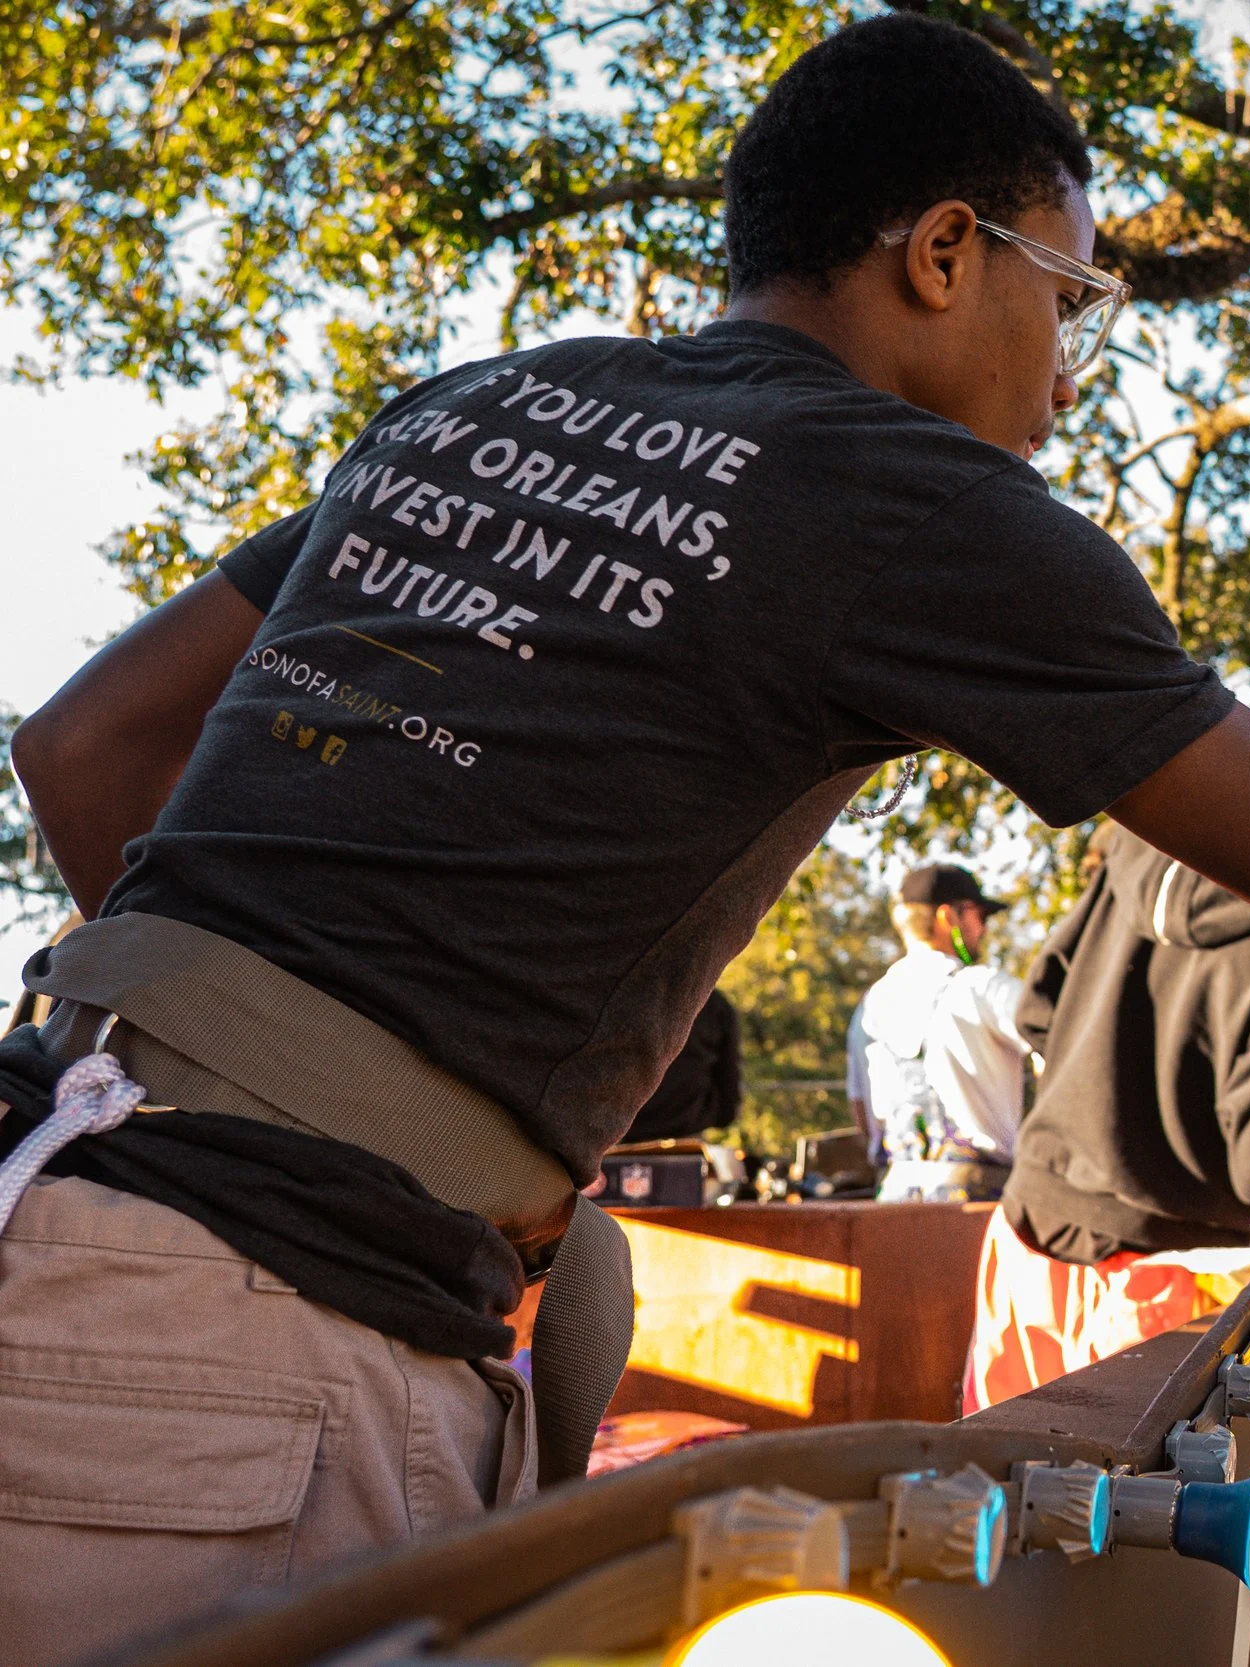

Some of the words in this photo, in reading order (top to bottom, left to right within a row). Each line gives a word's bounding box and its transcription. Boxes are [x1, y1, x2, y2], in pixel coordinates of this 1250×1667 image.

[453, 367, 517, 395] IF
[500, 373, 615, 435] YOU
[604, 412, 761, 485] LOVE
[331, 462, 496, 550] INVEST
[492, 519, 571, 581] IN
[569, 554, 675, 628] ITS
[375, 410, 480, 453] NEW
[470, 438, 731, 581] ORLEANS,
[328, 533, 540, 660] FUTURE.
[249, 648, 482, 768] SONOFASAINT.ORG
